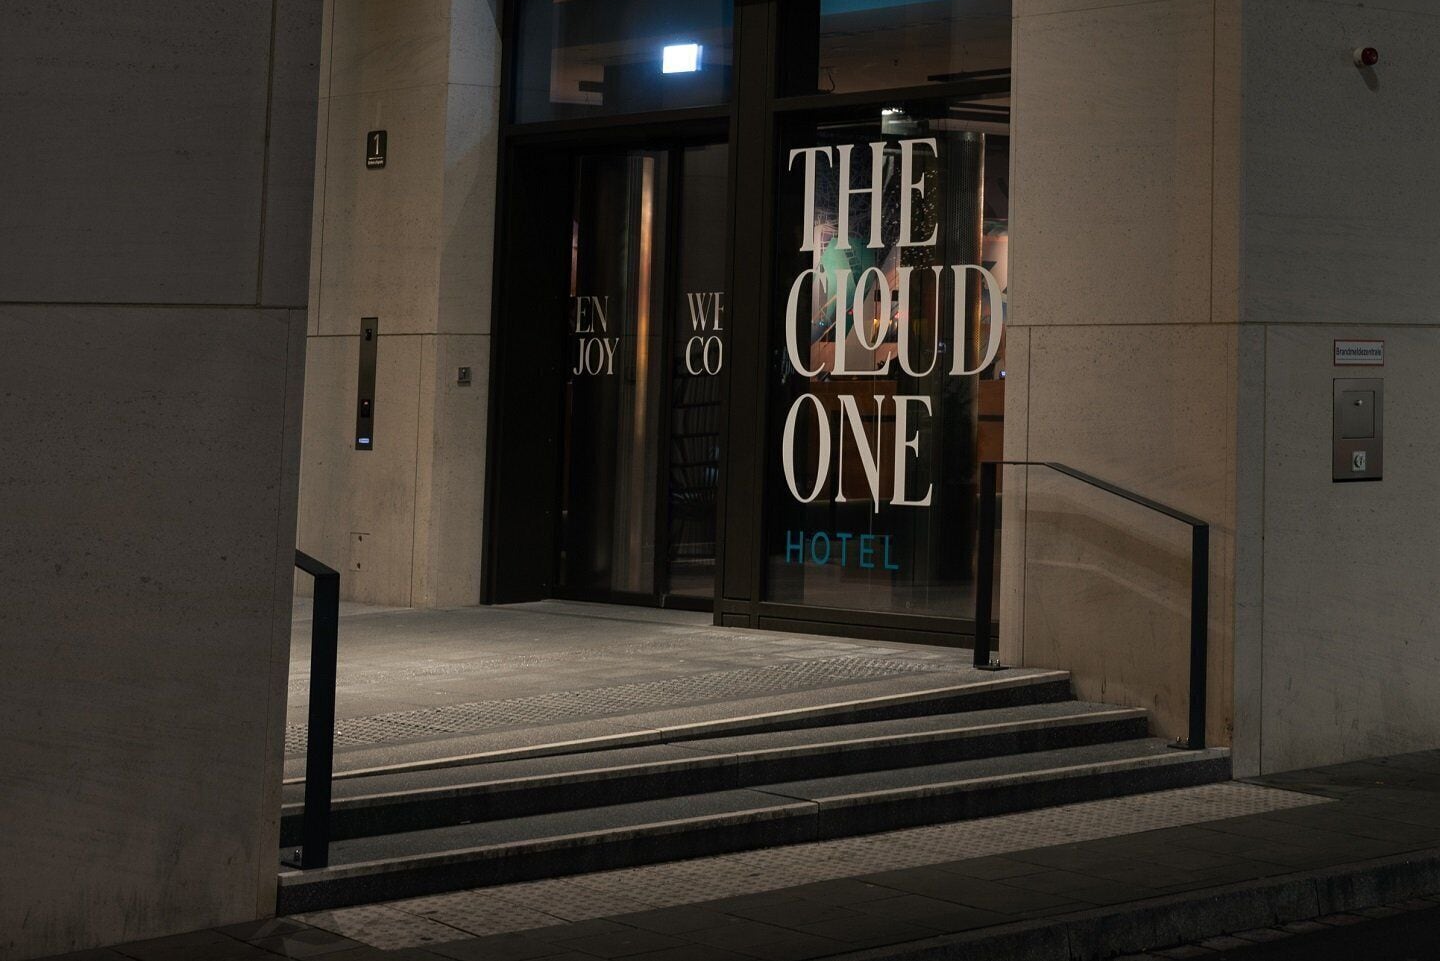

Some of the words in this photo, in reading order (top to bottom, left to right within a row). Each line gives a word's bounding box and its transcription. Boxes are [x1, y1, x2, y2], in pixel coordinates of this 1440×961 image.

[788, 137, 938, 252] THE
[575, 296, 609, 333] EN
[785, 263, 1002, 378] CLOUD
[573, 337, 620, 376] JOY
[782, 393, 933, 513] ONE
[785, 530, 899, 571] HOTEL
